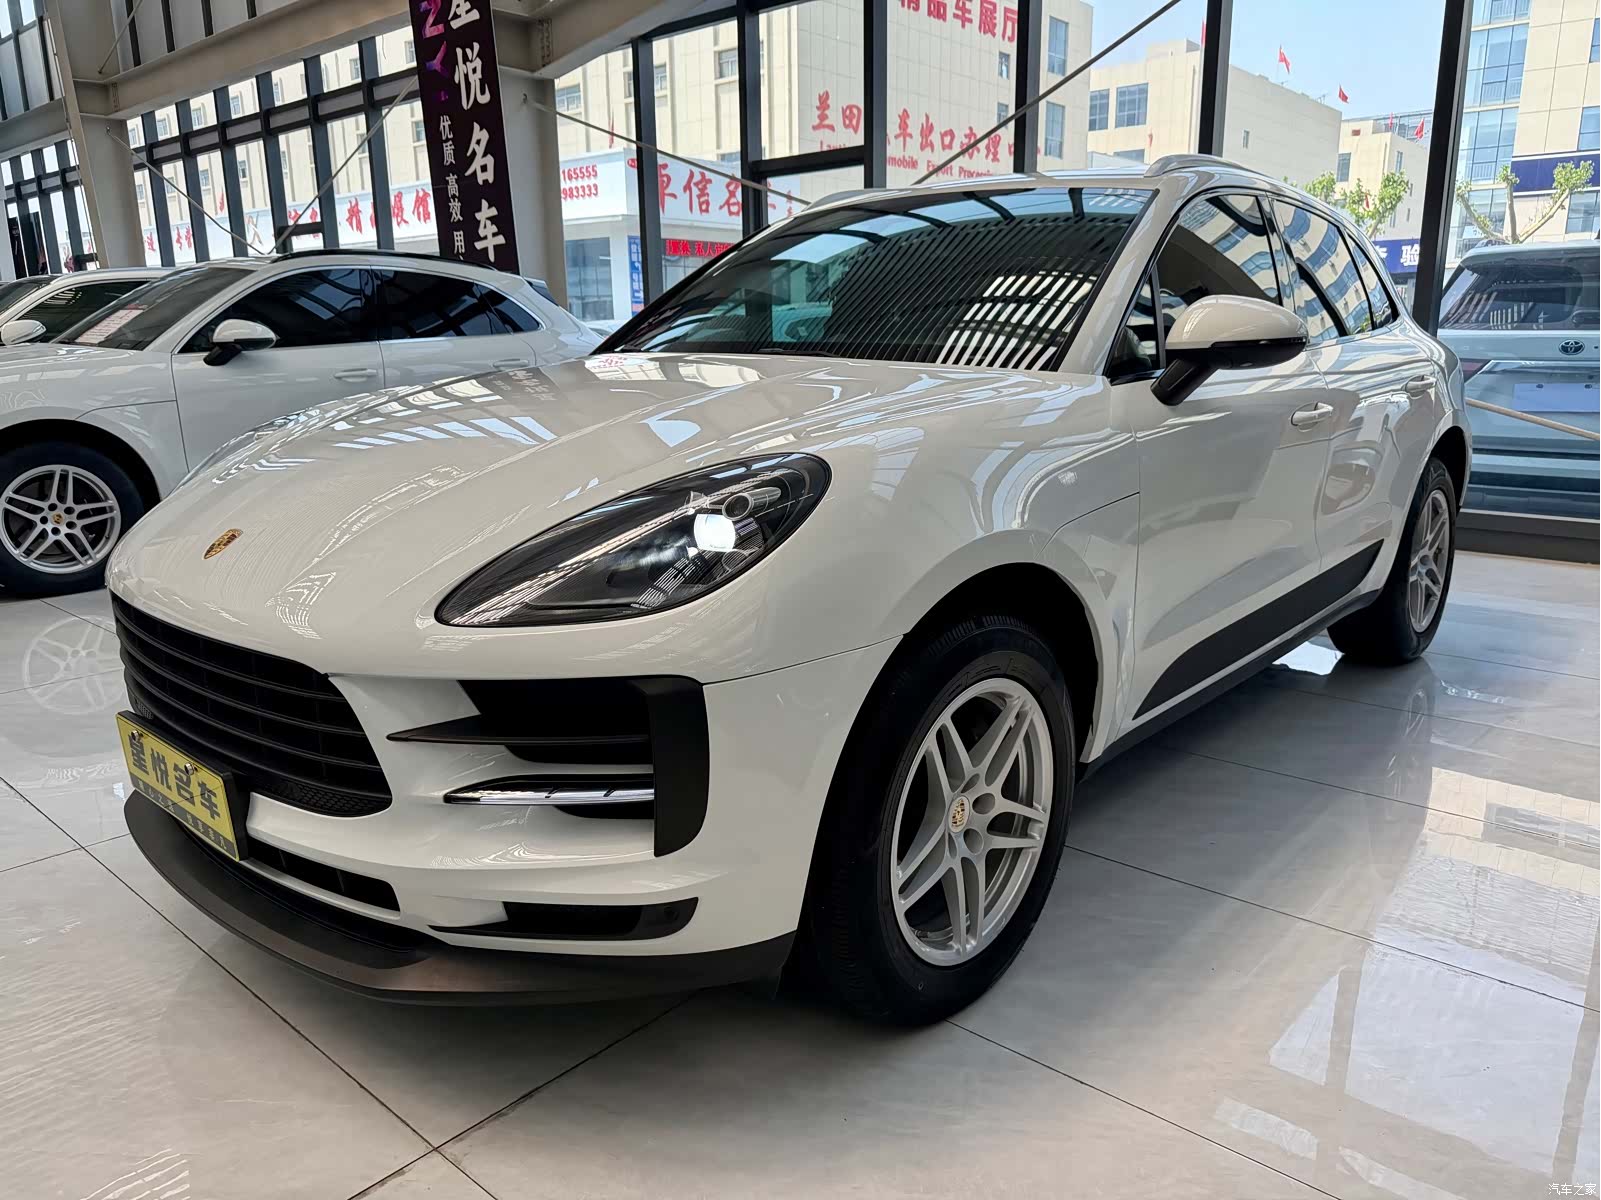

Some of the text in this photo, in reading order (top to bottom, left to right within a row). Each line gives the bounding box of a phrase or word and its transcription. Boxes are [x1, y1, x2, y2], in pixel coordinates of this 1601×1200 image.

[439, 114, 466, 260] 优质 高效 用
[561, 163, 598, 182] 165555
[561, 182, 599, 201] 983333
[345, 188, 431, 235] 精展馆
